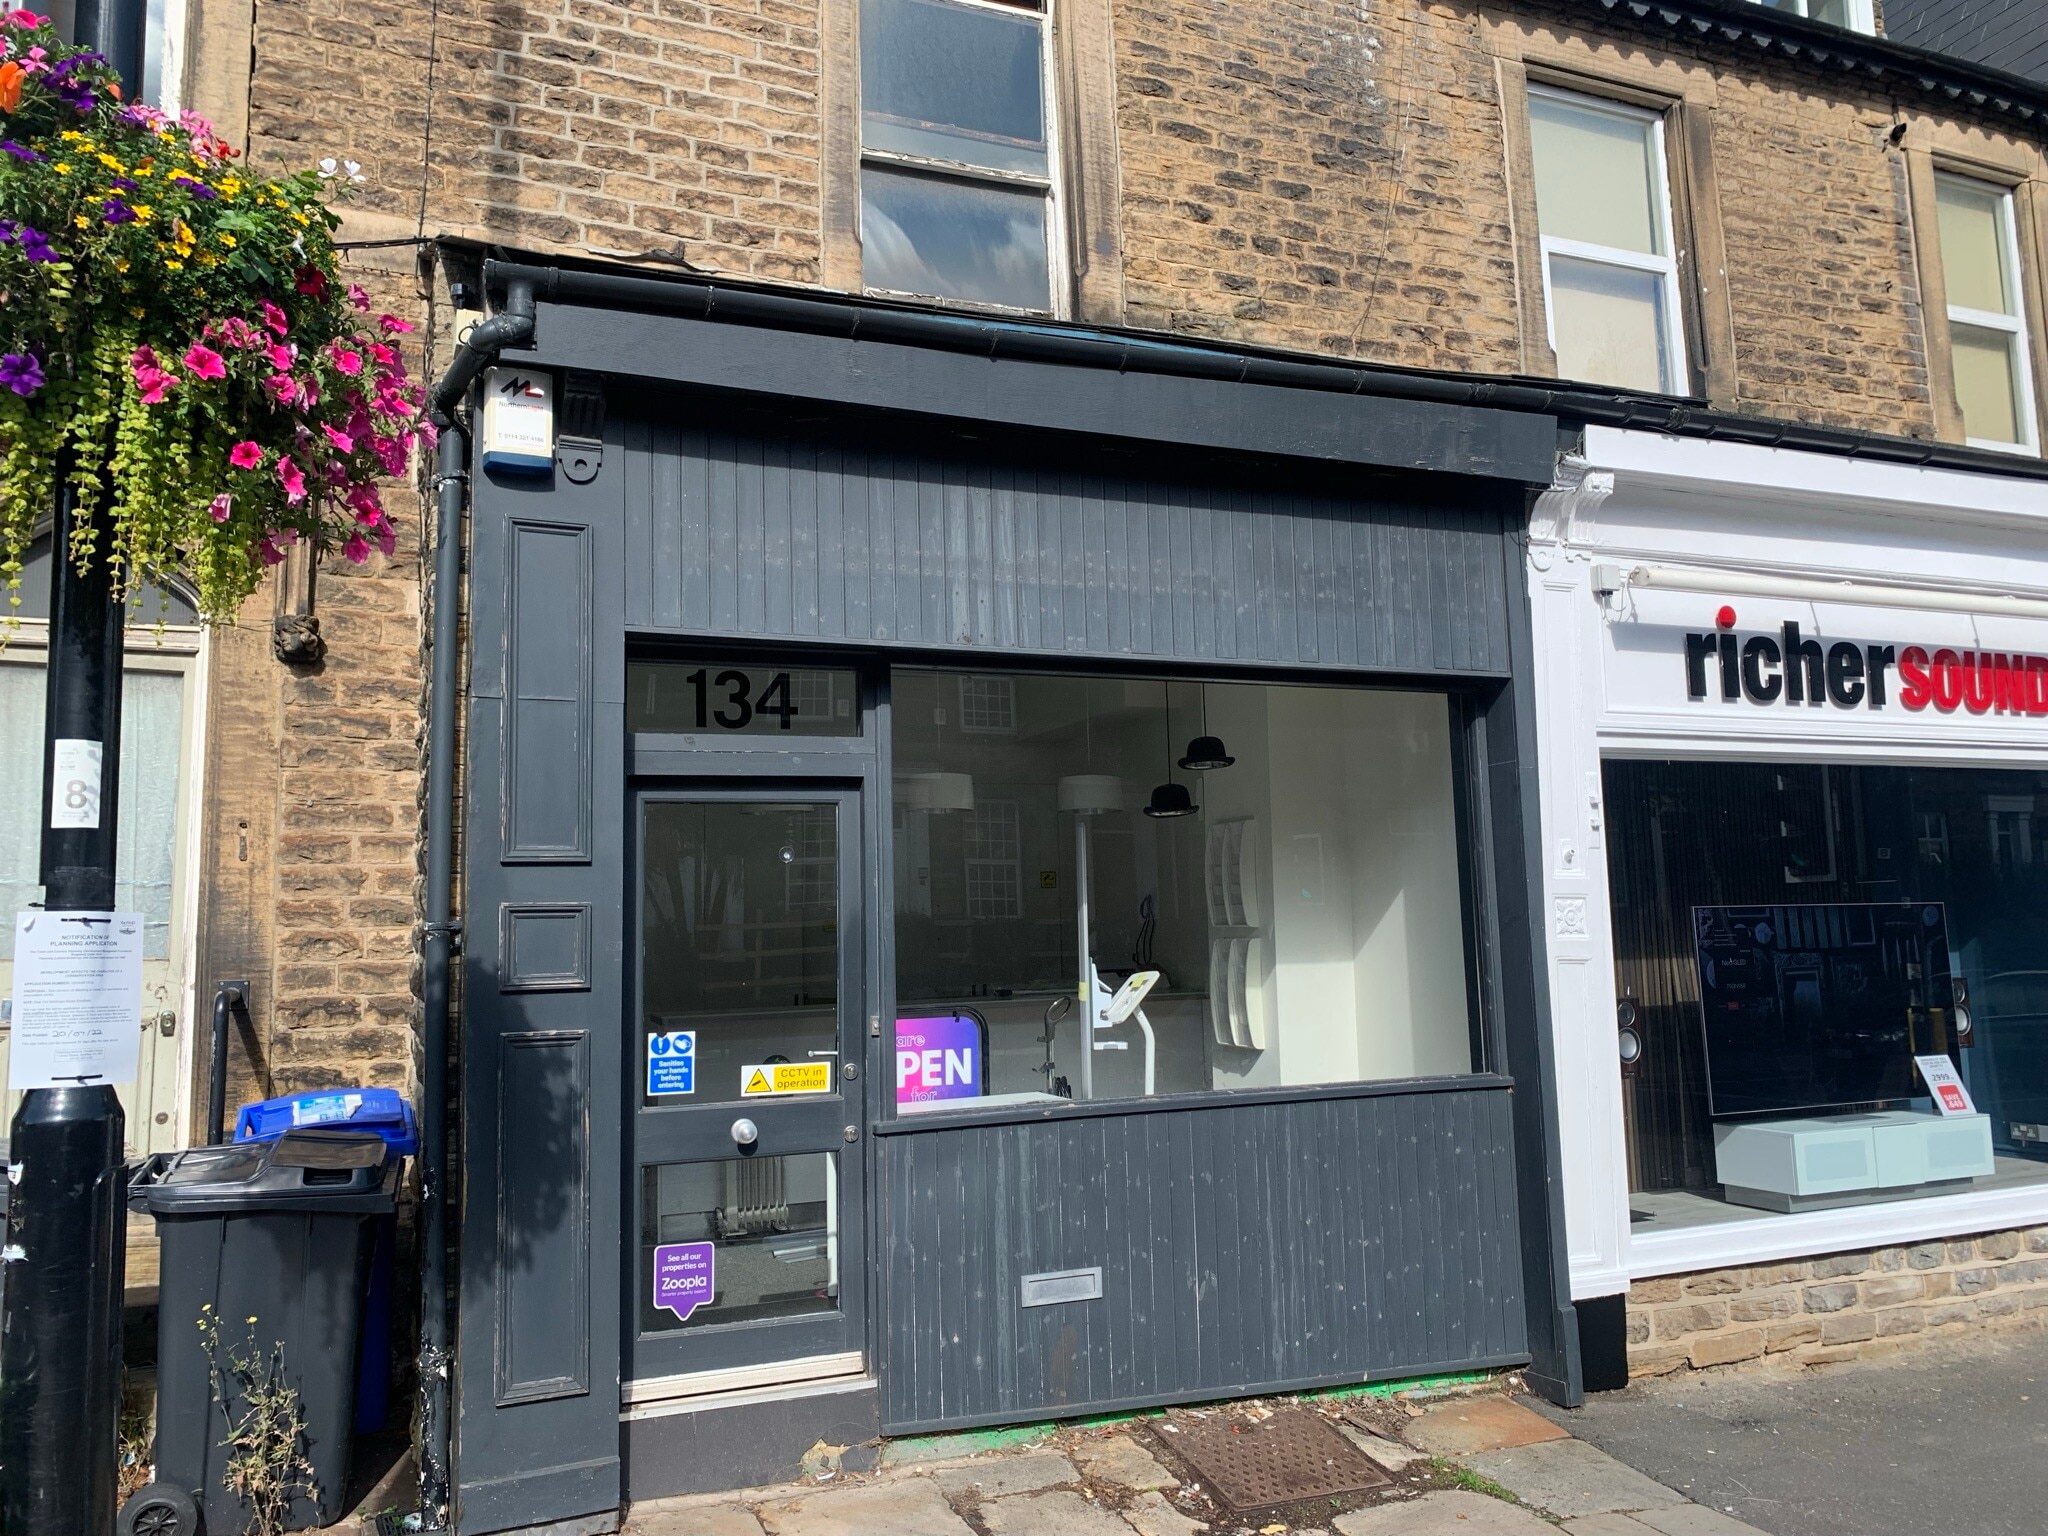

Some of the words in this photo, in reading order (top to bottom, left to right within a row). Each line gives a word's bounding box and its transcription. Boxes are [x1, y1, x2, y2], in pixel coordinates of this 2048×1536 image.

[686, 668, 799, 730] 134
[65, 779, 88, 809] 8
[896, 1034, 926, 1048] are
[653, 1068, 668, 1076] your
[780, 1068, 810, 1078] CCTV
[813, 1068, 822, 1076] in
[657, 1081, 685, 1089] entering
[777, 1079, 826, 1090] operation
[911, 1085, 938, 1102] for
[667, 1254, 680, 1262] See
[681, 1253, 689, 1261] all
[661, 1262, 697, 1273] properties
[661, 1275, 707, 1290] Zoopla
